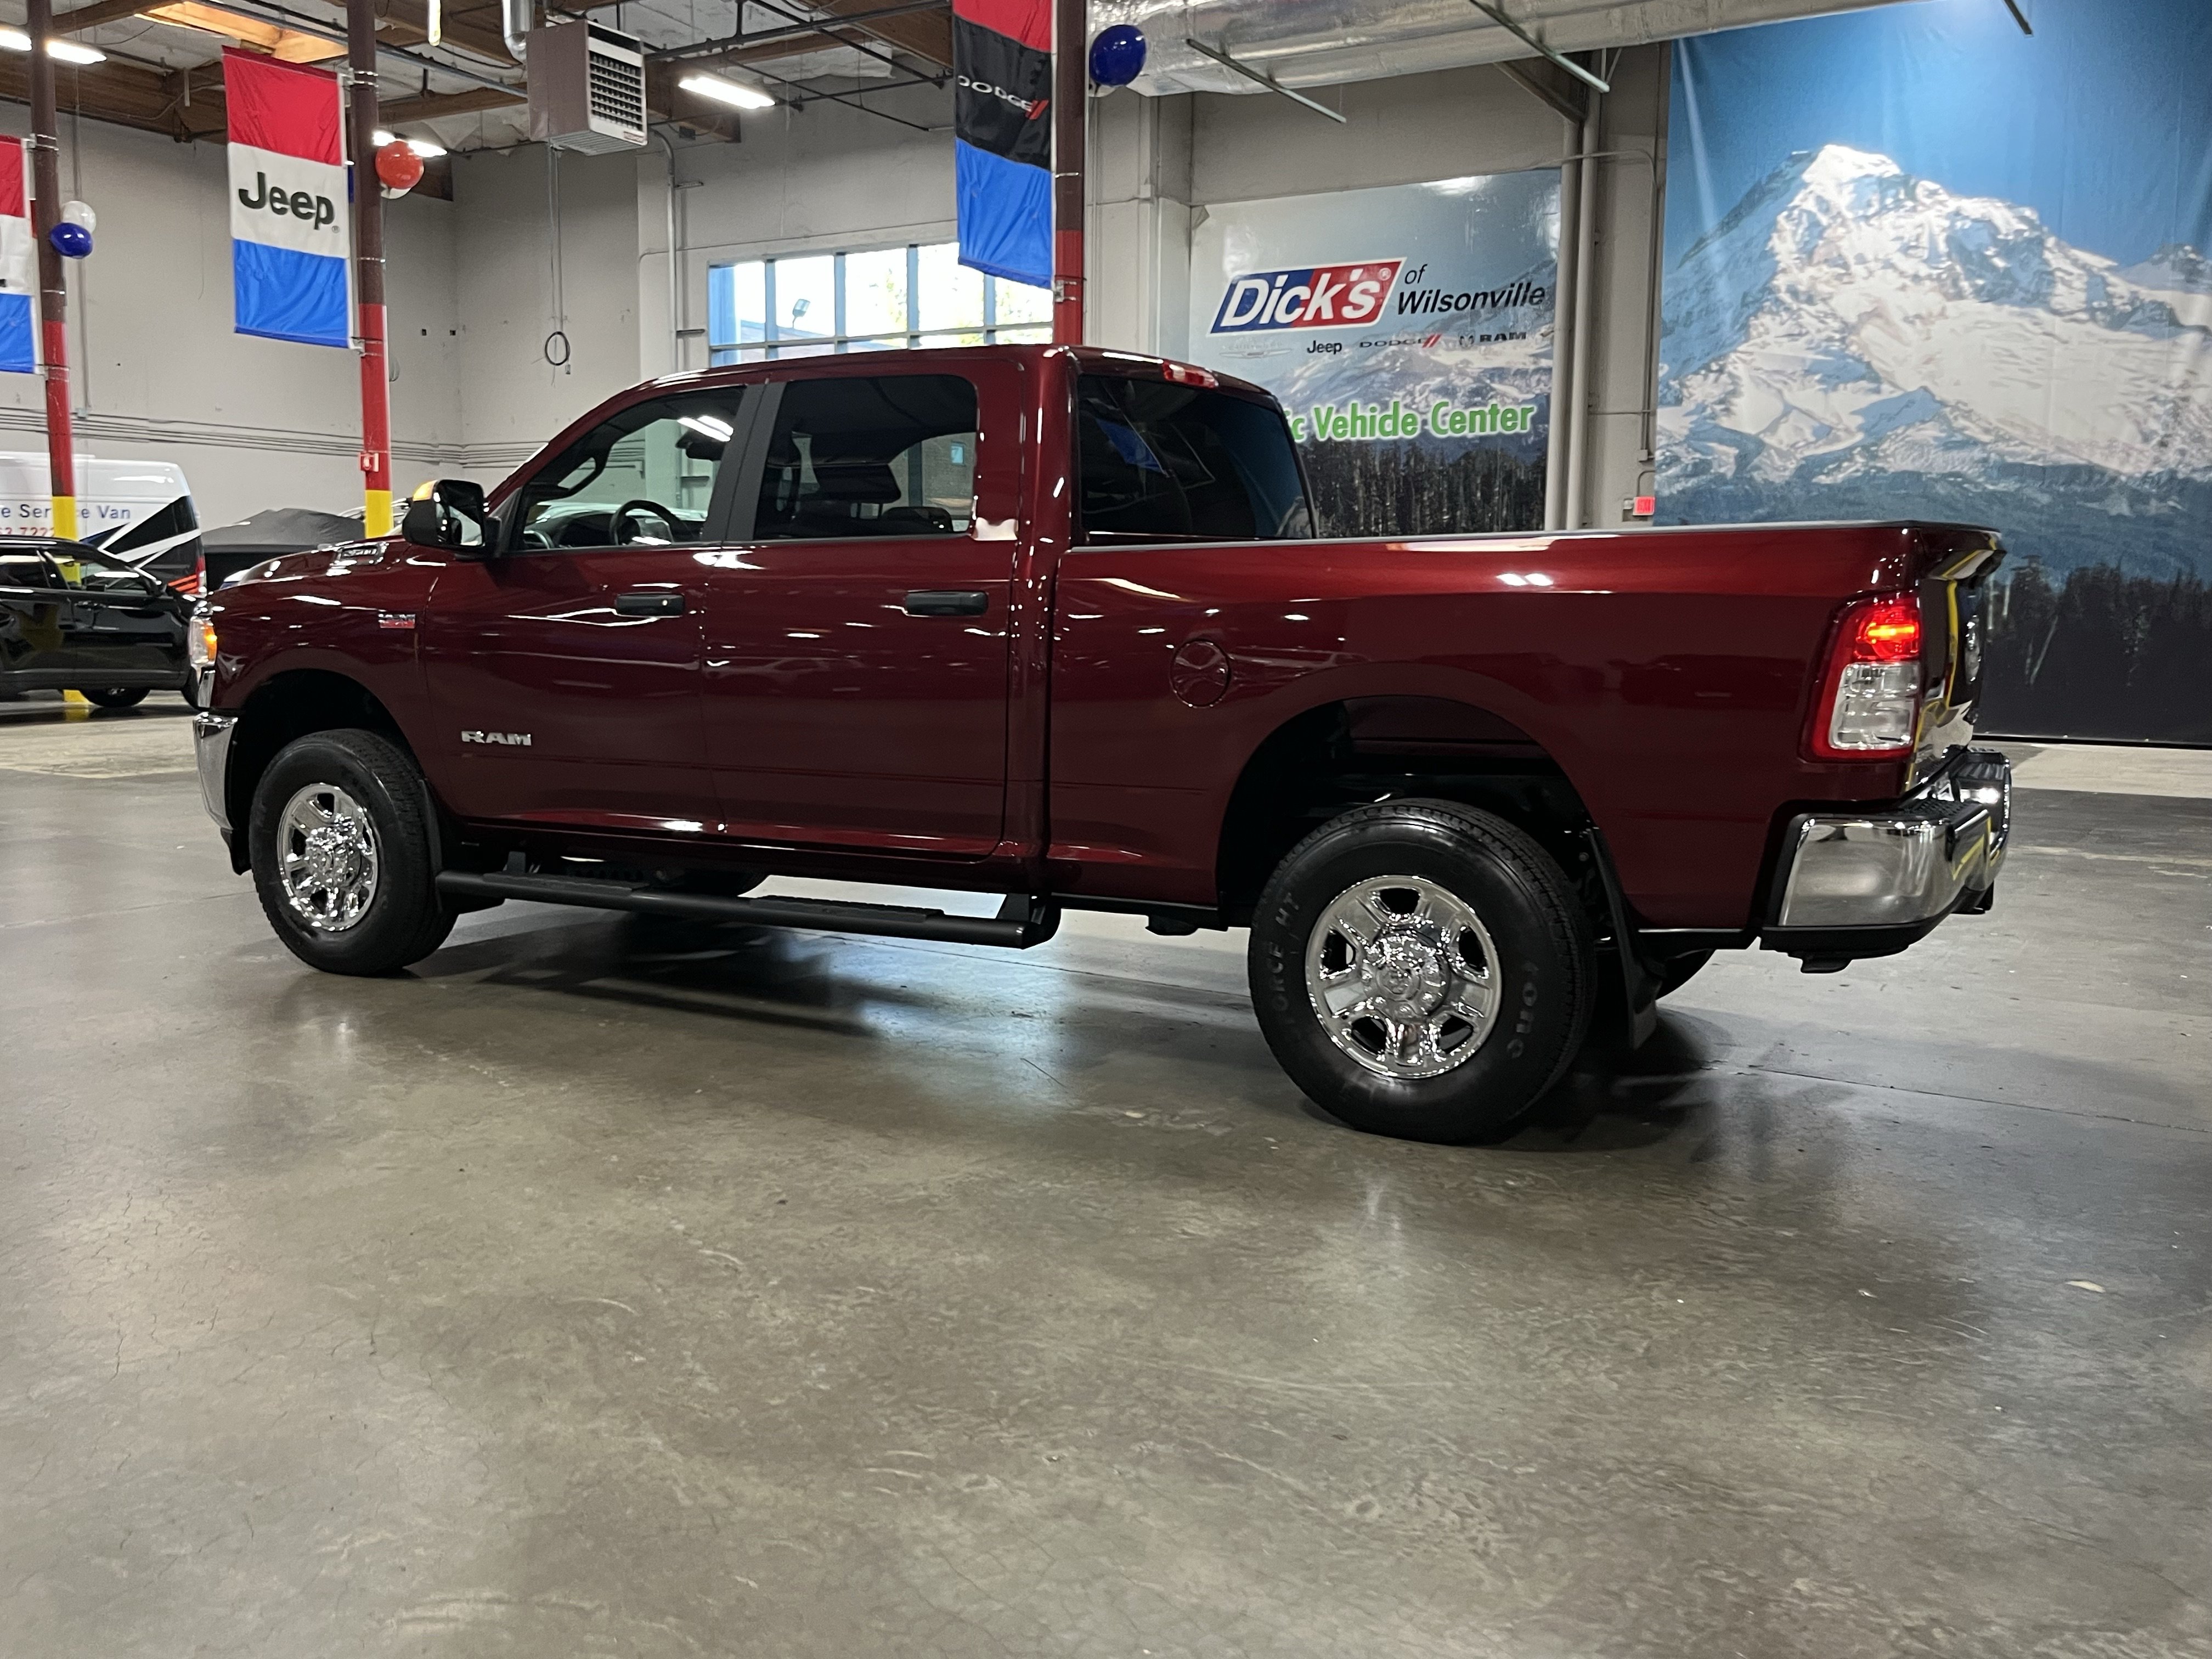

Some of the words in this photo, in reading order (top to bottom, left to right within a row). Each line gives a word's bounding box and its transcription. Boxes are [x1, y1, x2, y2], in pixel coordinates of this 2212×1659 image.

[958, 75, 1032, 112] DODGE
[238, 171, 335, 230] Jeep
[1404, 264, 1427, 284] of
[1220, 268, 1380, 327] Dick's
[1398, 281, 1545, 315] Wilsonville
[1307, 340, 1342, 354] Jeep
[1480, 331, 1526, 342] RAM
[1314, 401, 1418, 439] Vehicle
[1431, 401, 1535, 435] Center
[19, 504, 90, 518] Sere
[97, 505, 131, 519] Van
[461, 731, 532, 746] RAM
